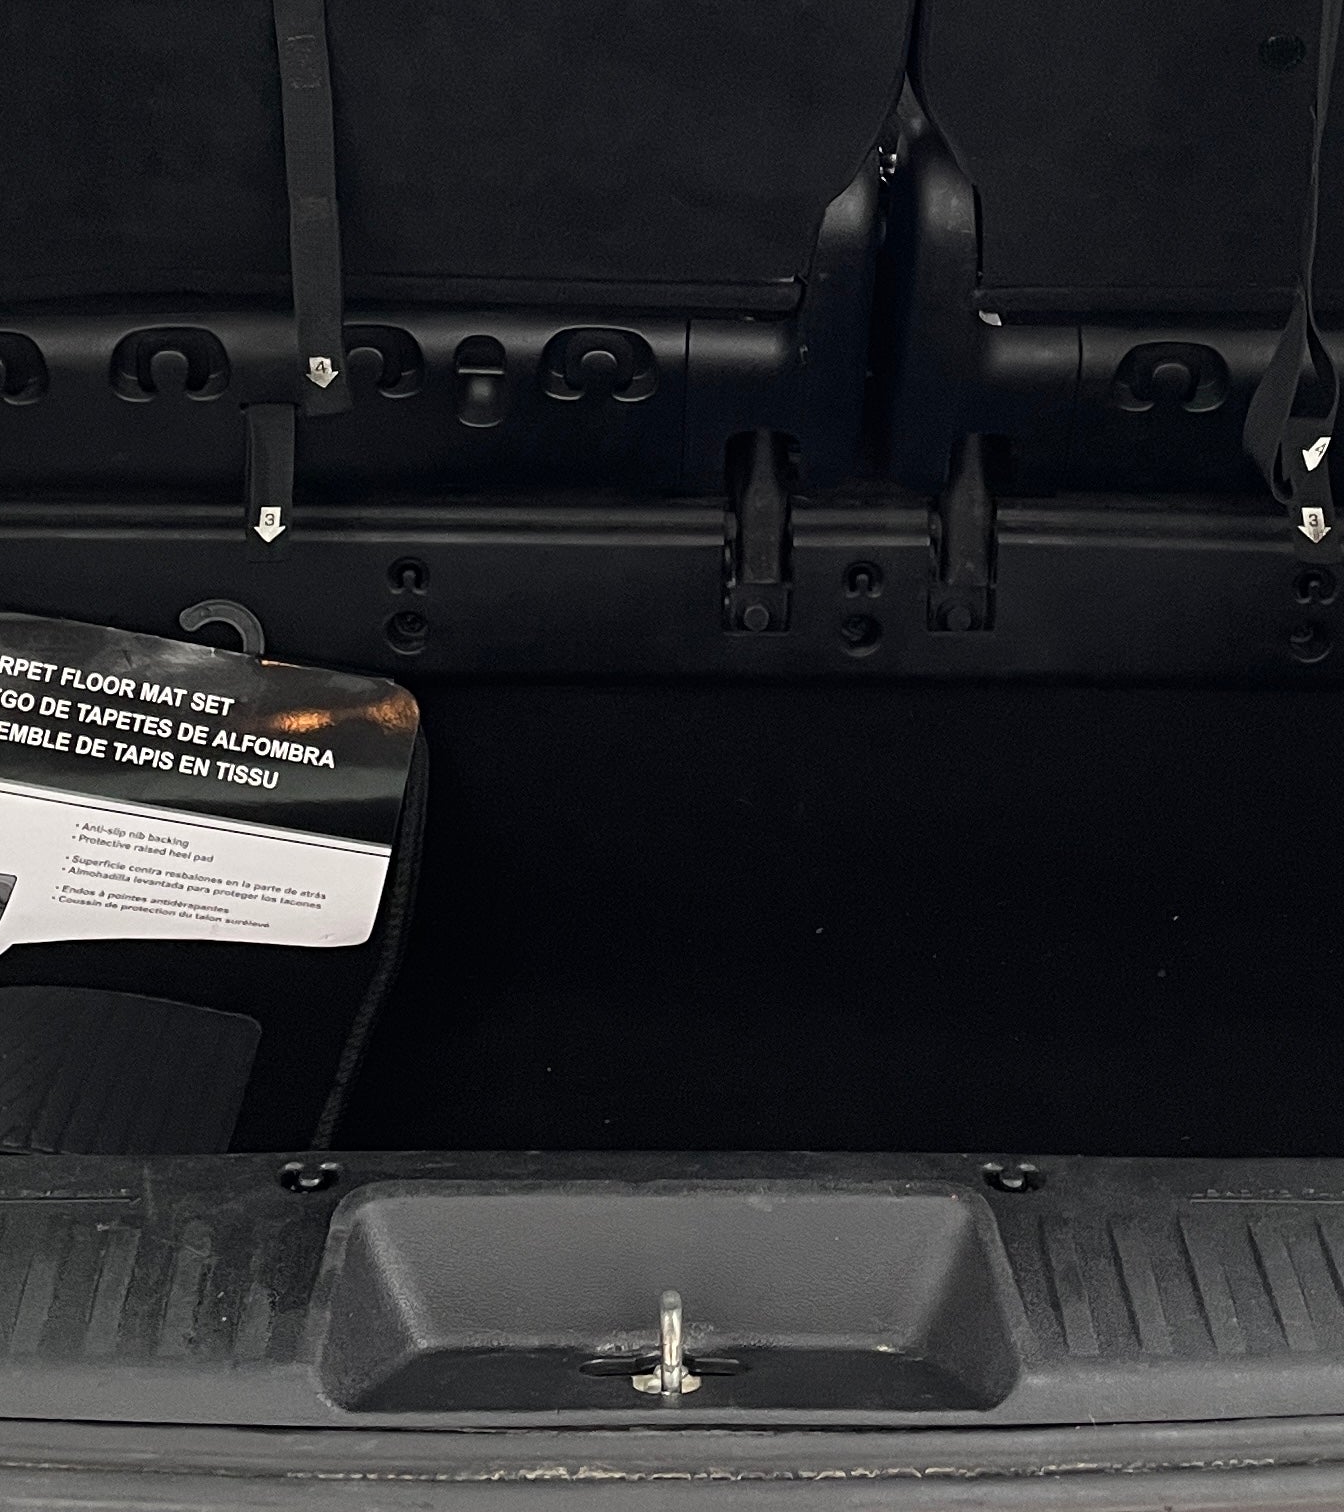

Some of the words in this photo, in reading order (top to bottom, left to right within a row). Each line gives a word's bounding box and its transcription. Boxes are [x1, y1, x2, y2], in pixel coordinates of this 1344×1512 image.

[315, 360, 327, 374] 4
[264, 513, 275, 527] 3
[1308, 513, 1319, 528] 3
[60, 666, 136, 699] FLOOR
[139, 682, 187, 708] MAT
[190, 692, 235, 717] SET
[38, 696, 72, 719] DE
[76, 703, 173, 738] TAPETES
[177, 722, 210, 745] DE
[211, 729, 336, 769] ALFOMBRA
[74, 735, 108, 758] DE
[112, 741, 174, 771] TAPIS
[178, 754, 211, 778] EN
[216, 761, 279, 790] TISSU
[78, 833, 132, 850] Protective
[133, 844, 167, 855] raised
[168, 847, 192, 859] heel
[192, 852, 214, 862] pad
[147, 833, 190, 848] backing
[67, 866, 132, 882] Almohadilla
[133, 876, 185, 890] levantada
[186, 884, 211, 894] para
[212, 888, 259, 900] proteger
[260, 894, 277, 903] los
[279, 897, 322, 909] tacones
[71, 855, 126, 871] Superficie
[128, 864, 163, 876] contra
[164, 870, 223, 884] resbalones
[225, 879, 239, 887] en
[241, 880, 251, 889] la
[253, 883, 282, 893] parte
[283, 887, 298, 896] de
[61, 884, 96, 896] Endos
[107, 892, 148, 903] pointes
[58, 895, 102, 907] Coussin
[104, 901, 119, 910] de
[120, 903, 176, 917] protection
[178, 910, 193, 920] du
[195, 913, 223, 923] talon
